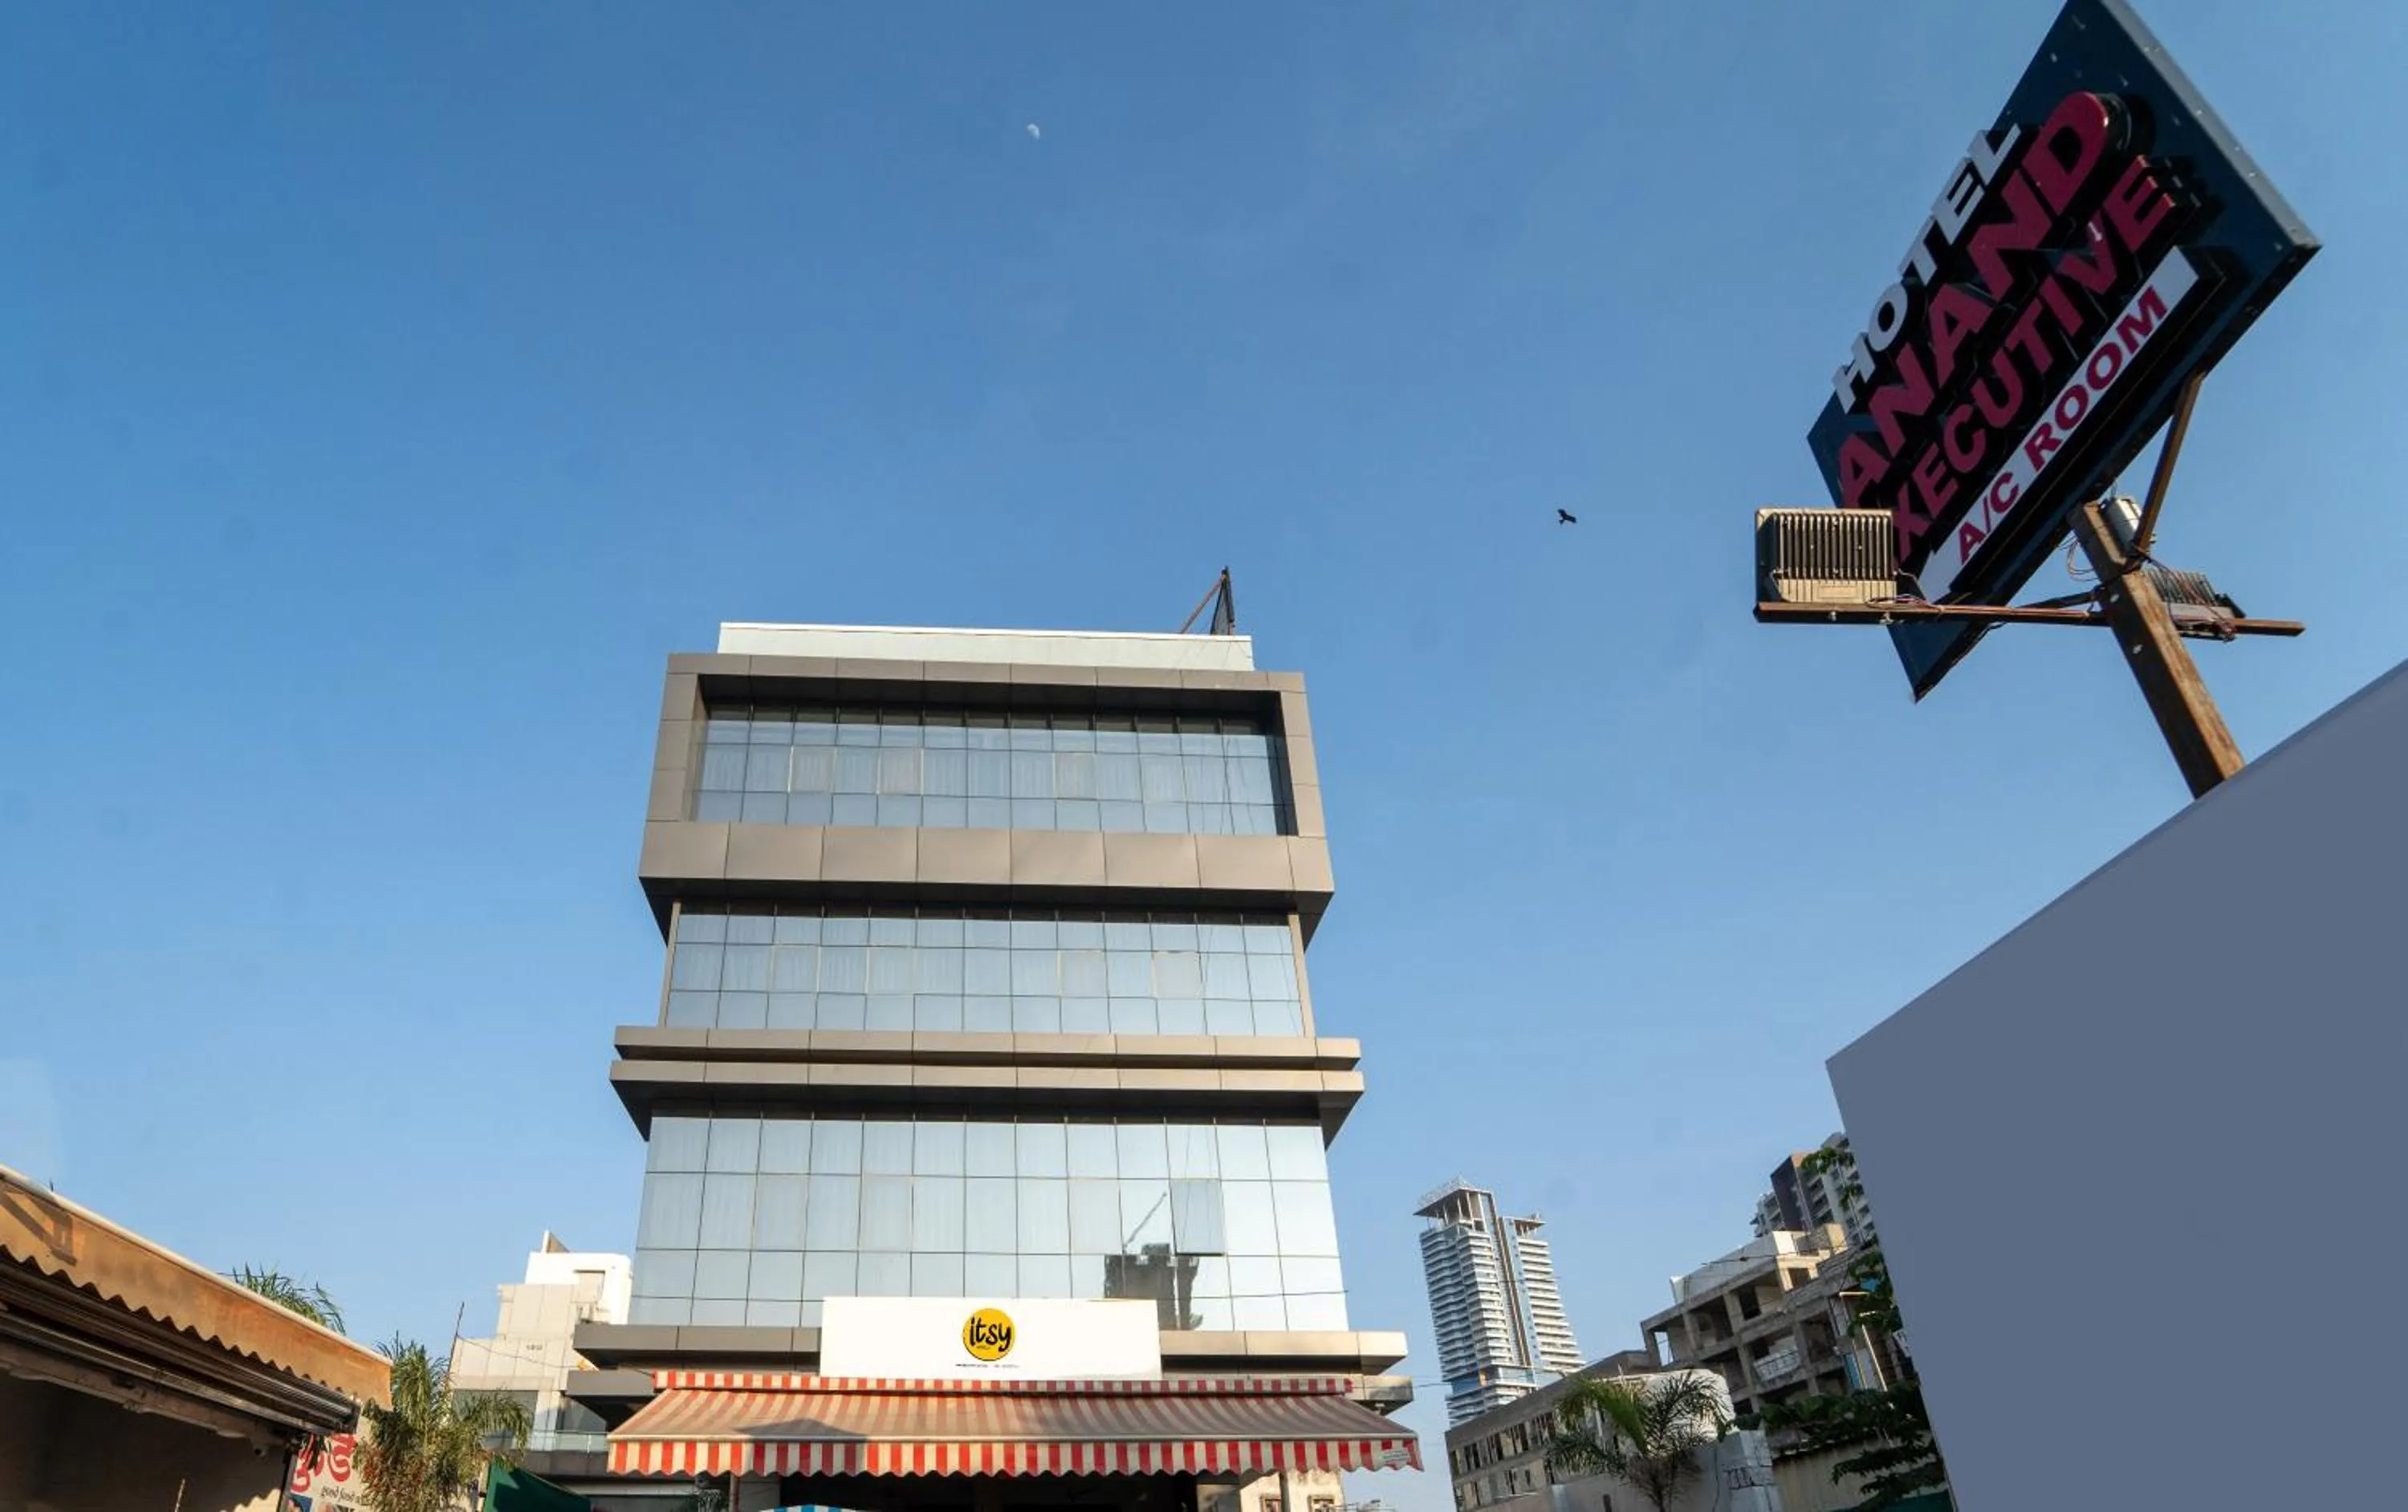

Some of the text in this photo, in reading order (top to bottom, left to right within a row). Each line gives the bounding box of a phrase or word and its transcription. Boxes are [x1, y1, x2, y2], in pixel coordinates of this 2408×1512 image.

[1831, 123, 2022, 413] HOTEL
[1837, 91, 2109, 509] ANAND
[1892, 154, 2176, 569] XECUTIVE
[1957, 285, 2168, 565] A/C ROOM
[970, 1316, 1011, 1352] itsy
